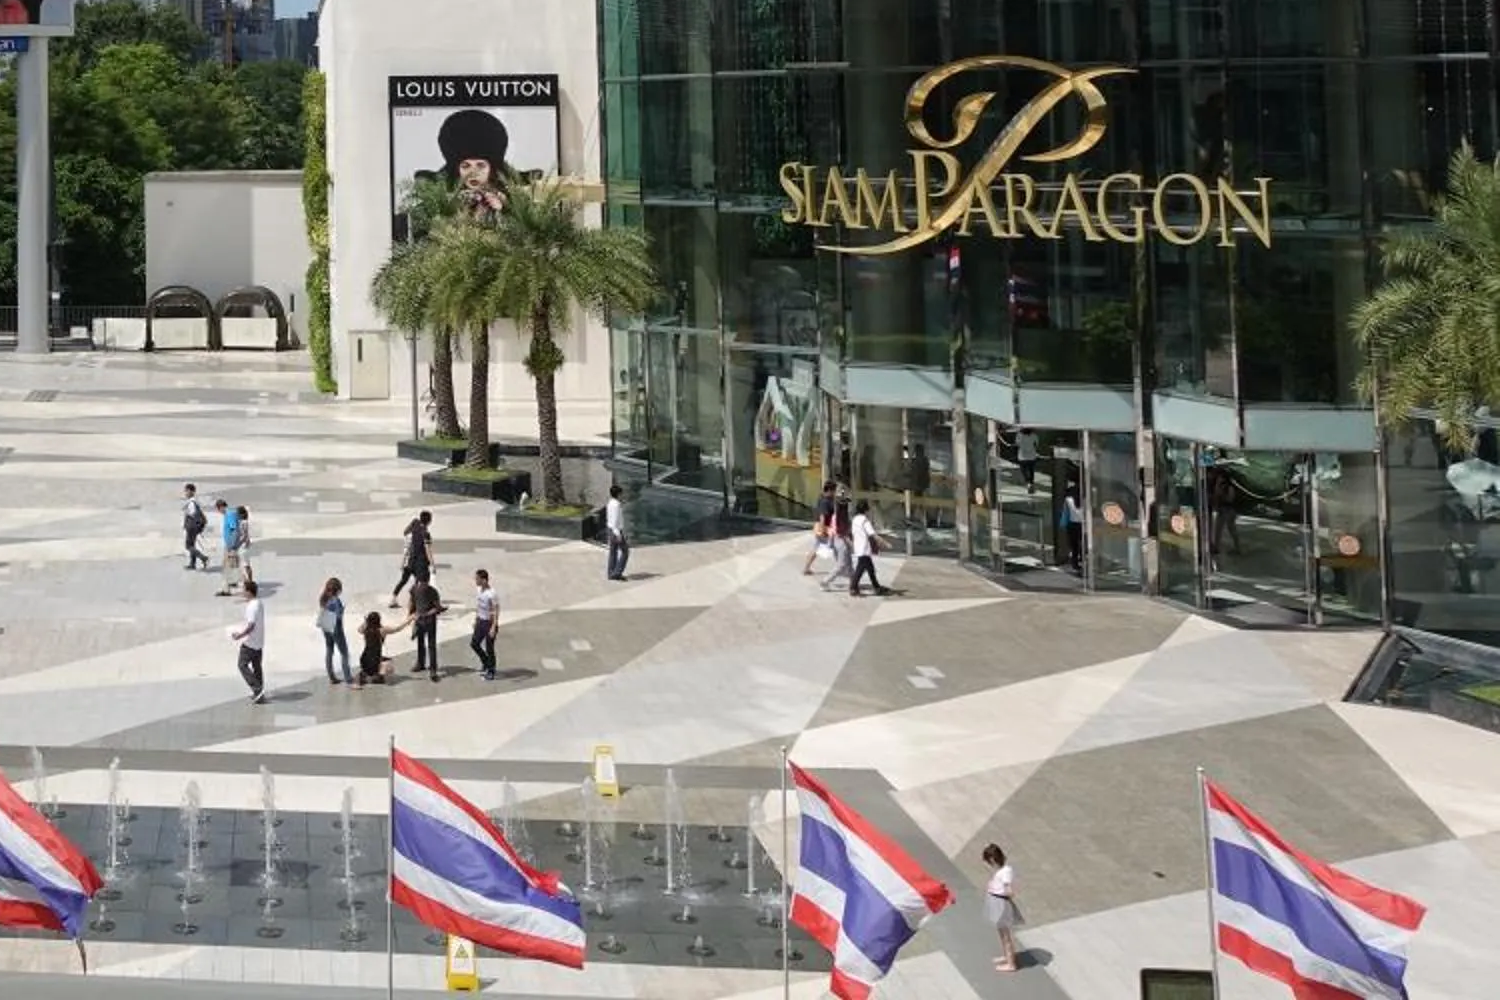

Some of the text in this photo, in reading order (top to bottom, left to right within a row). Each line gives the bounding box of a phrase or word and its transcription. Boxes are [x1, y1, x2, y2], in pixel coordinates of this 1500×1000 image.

[396, 80, 552, 98] LOUIS VUITTON
[778, 149, 1274, 249] SIAM PARAGON
